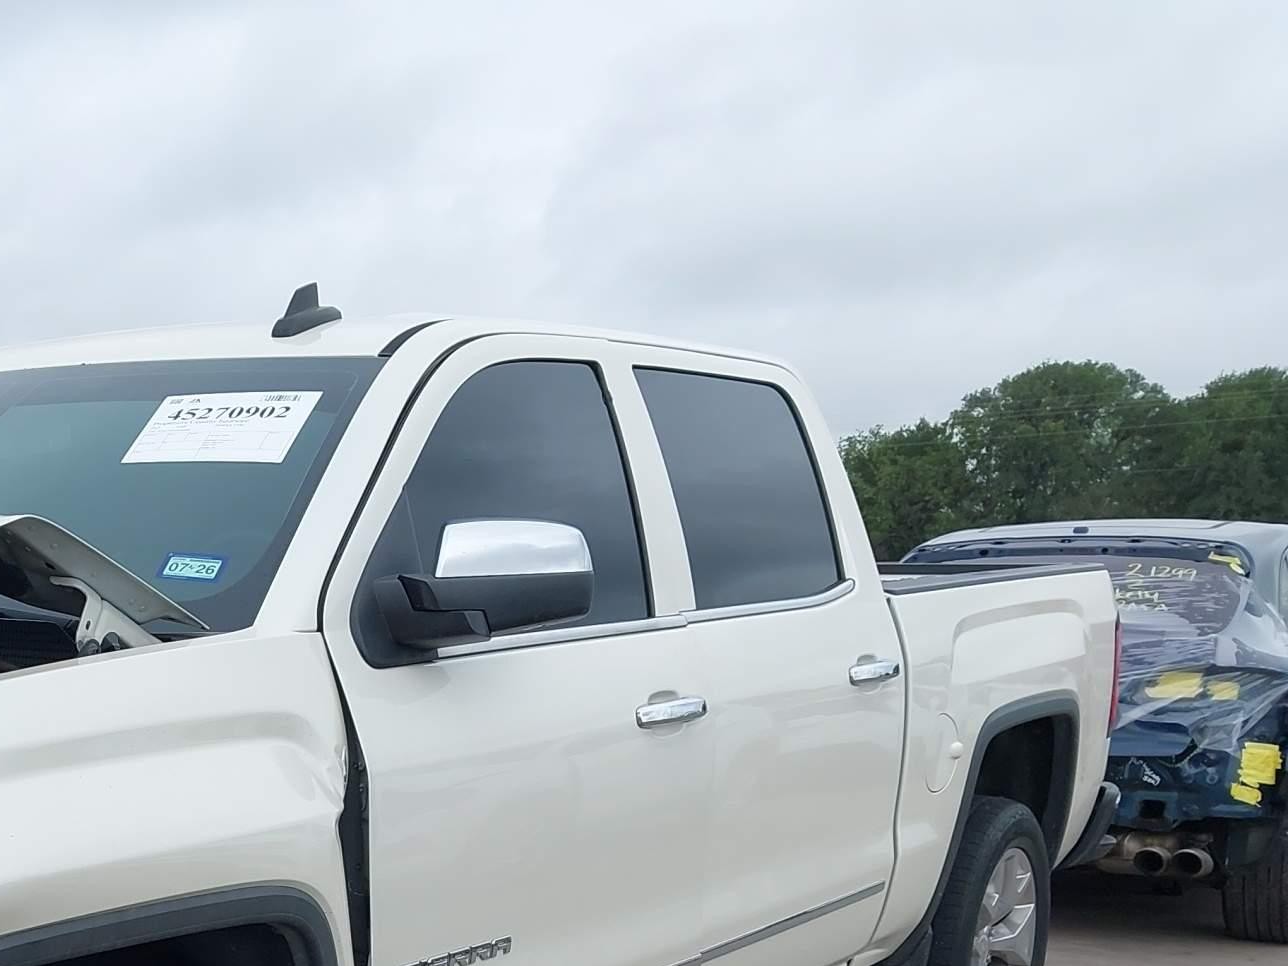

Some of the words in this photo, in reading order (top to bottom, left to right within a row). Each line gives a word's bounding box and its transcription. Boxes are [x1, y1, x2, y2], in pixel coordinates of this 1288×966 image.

[168, 405, 292, 421] 45270902
[168, 562, 189, 573] 07
[195, 564, 217, 575] 26
